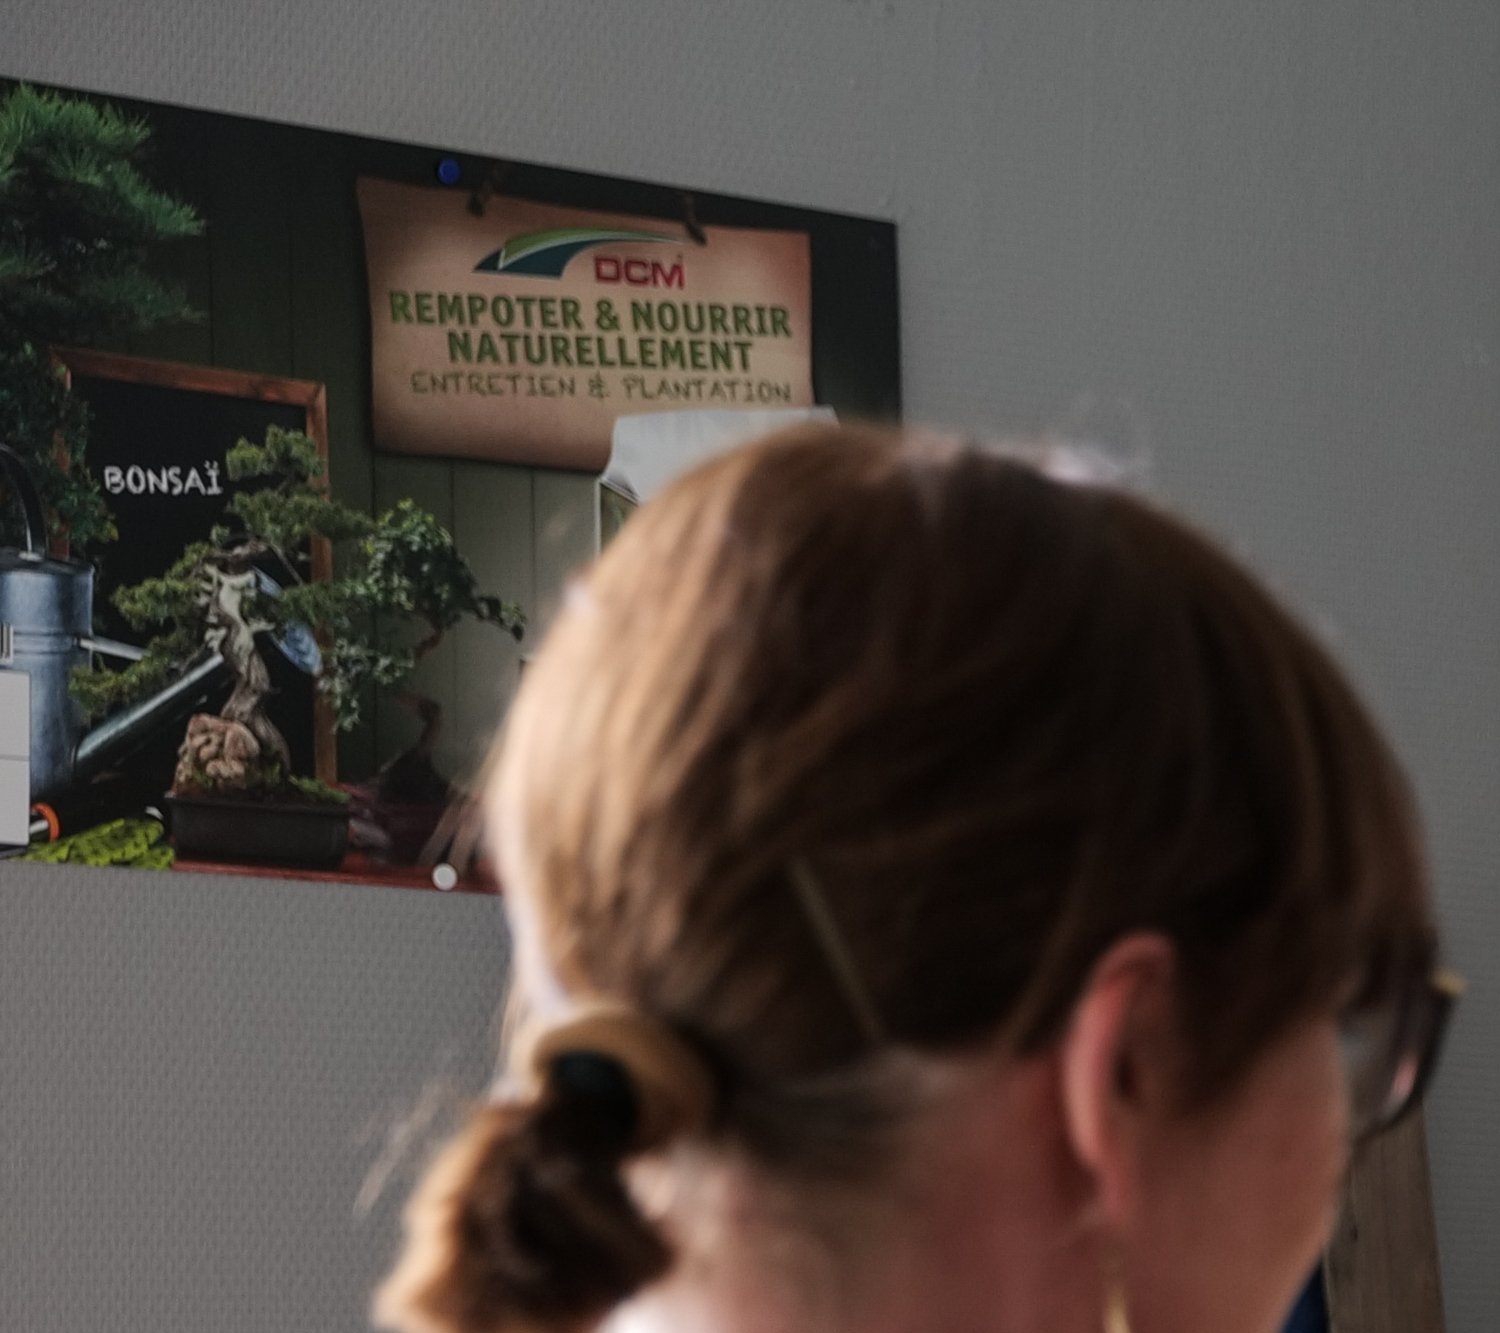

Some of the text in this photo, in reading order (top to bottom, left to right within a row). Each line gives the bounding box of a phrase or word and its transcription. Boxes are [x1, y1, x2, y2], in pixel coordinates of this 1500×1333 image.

[593, 255, 686, 289] DCM
[389, 290, 793, 339] REMPOTER & NOURRIR
[447, 329, 754, 374] NATURELLEMENT
[410, 369, 577, 398] ENTRETIEN
[623, 375, 793, 403] PLANTATION
[104, 460, 224, 497] BONSAÏ
